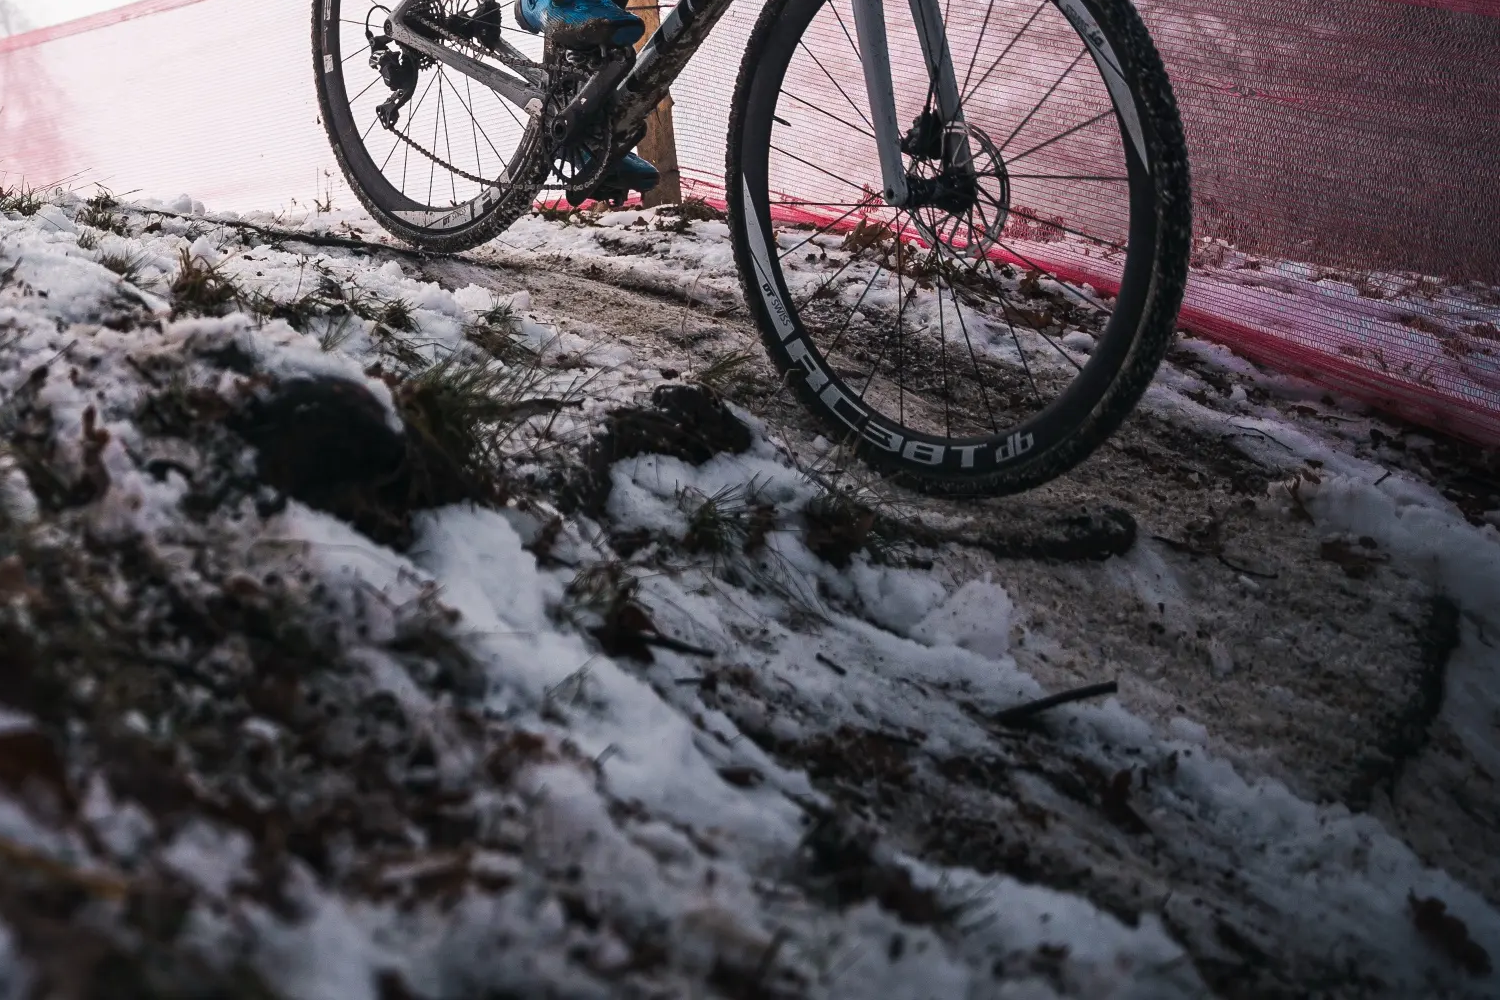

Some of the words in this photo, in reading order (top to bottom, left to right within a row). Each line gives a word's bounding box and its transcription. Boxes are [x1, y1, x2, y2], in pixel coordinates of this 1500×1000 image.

[761, 281, 775, 298] DT
[770, 297, 792, 328] SWISS
[994, 430, 1035, 464] db
